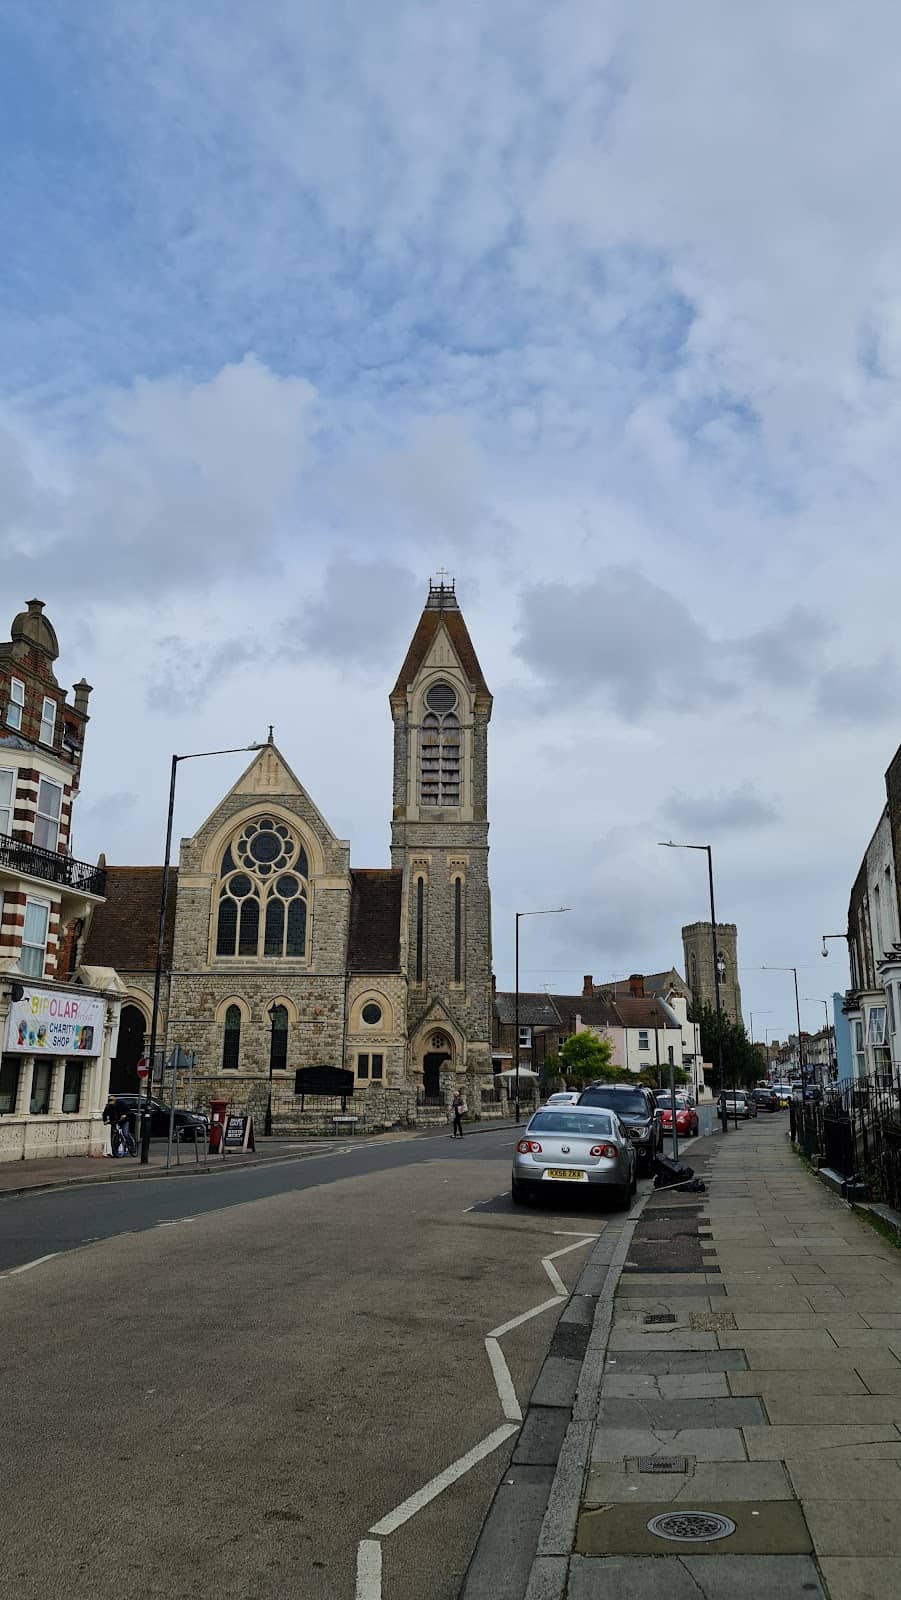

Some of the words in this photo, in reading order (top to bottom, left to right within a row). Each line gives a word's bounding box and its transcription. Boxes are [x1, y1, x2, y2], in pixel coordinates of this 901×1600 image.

[31, 996, 79, 1018] BIPOLAR
[49, 1022, 75, 1035] CHARITY
[52, 1035, 70, 1047] SHOP
